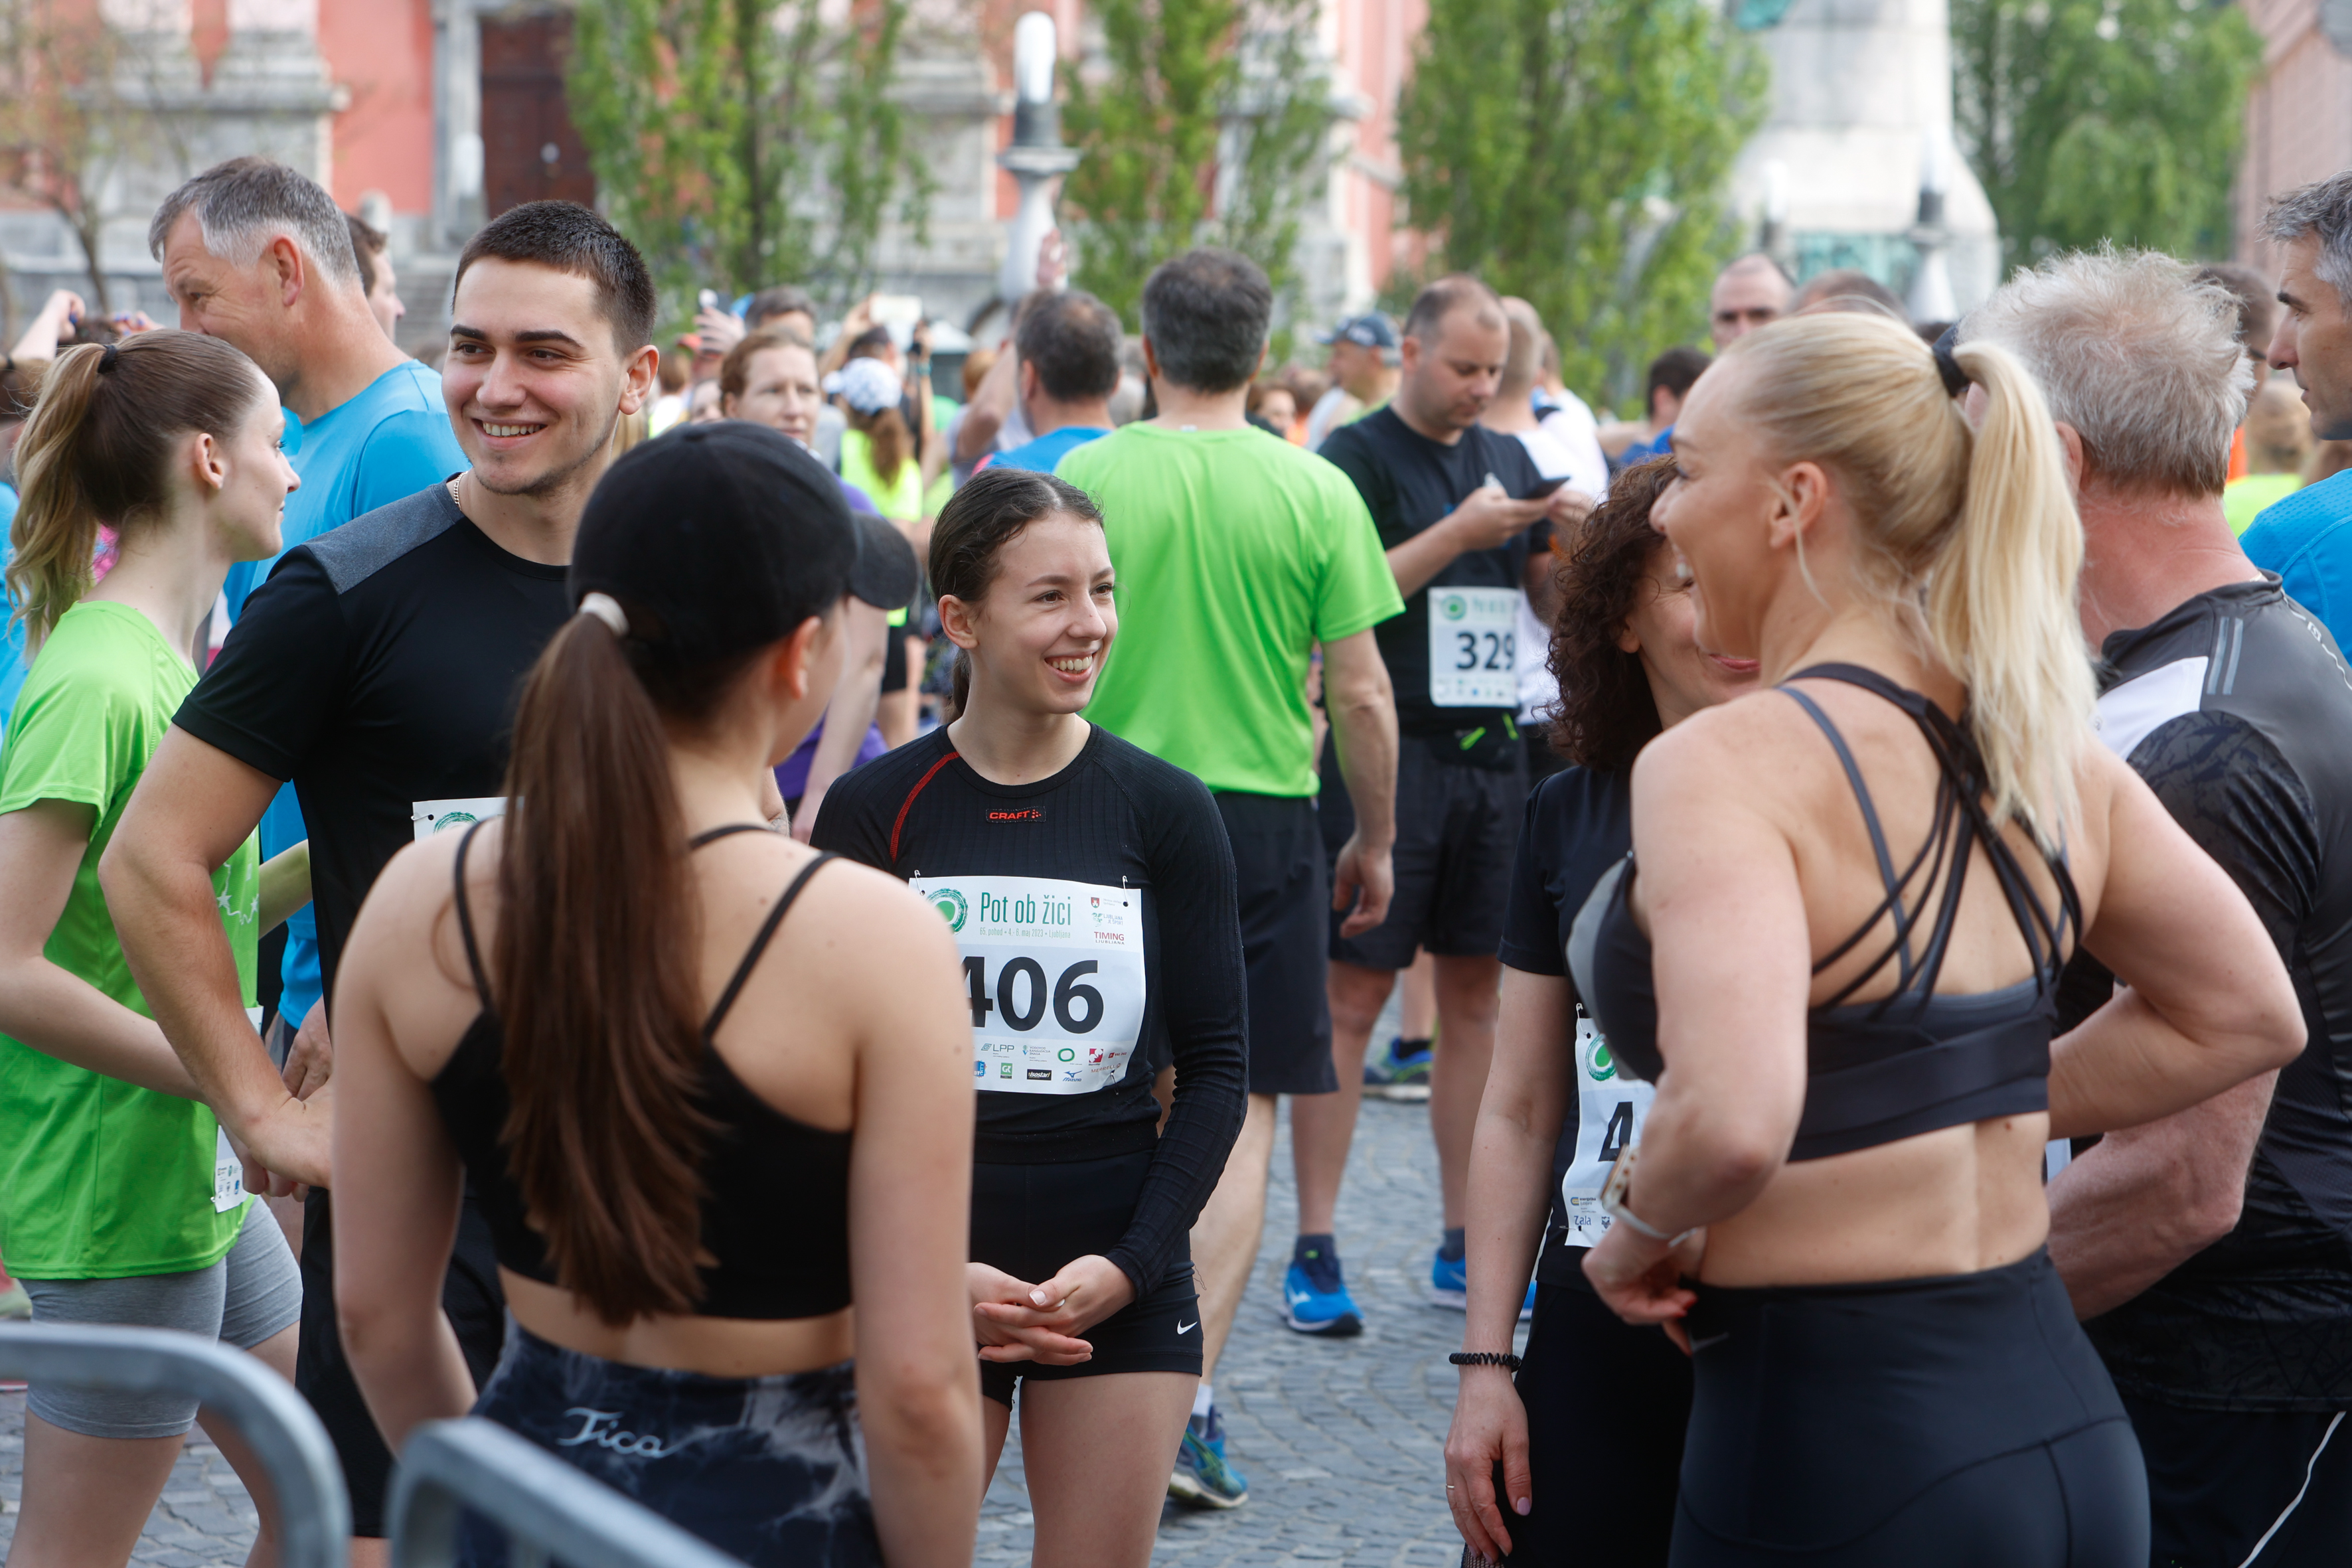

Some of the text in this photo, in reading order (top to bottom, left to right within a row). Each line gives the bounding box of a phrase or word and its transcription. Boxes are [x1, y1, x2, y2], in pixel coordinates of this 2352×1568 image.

[1455, 631, 1515, 670] 329
[989, 811, 1030, 819] CRAFT
[980, 892, 1071, 925] Pot ob žici
[988, 927, 1003, 937] pohod
[1021, 929, 1030, 937] maj
[1049, 929, 1071, 939] Ljubljana
[1094, 931, 1125, 941] TIMING
[960, 956, 1104, 1034] 406
[1091, 1065, 1115, 1073] MERRELL
[1574, 1215, 1592, 1225] Zala
